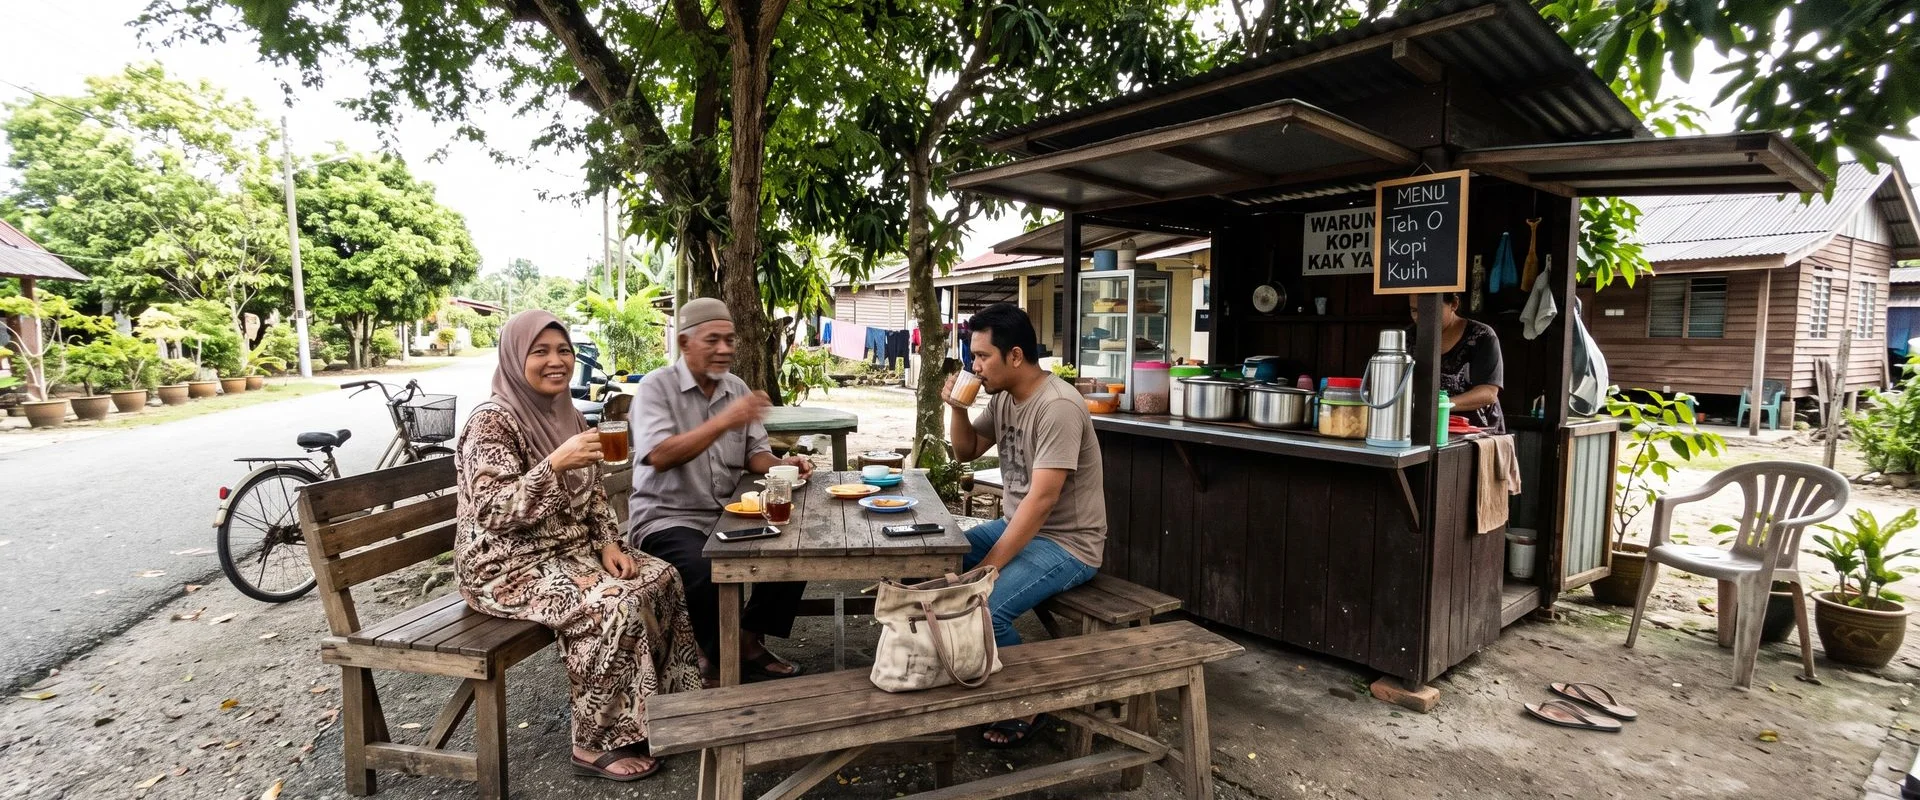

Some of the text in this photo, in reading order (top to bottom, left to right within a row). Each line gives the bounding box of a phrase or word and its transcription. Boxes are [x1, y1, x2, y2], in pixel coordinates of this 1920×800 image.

[1398, 184, 1446, 205] MENU
[1310, 212, 1376, 233] WARUN
[1386, 210, 1443, 233] Teh O
[1326, 231, 1370, 251] KOPI
[1388, 236, 1427, 261] Kopi
[1308, 251, 1374, 270] KAK YA
[1388, 260, 1428, 282] Kuih
